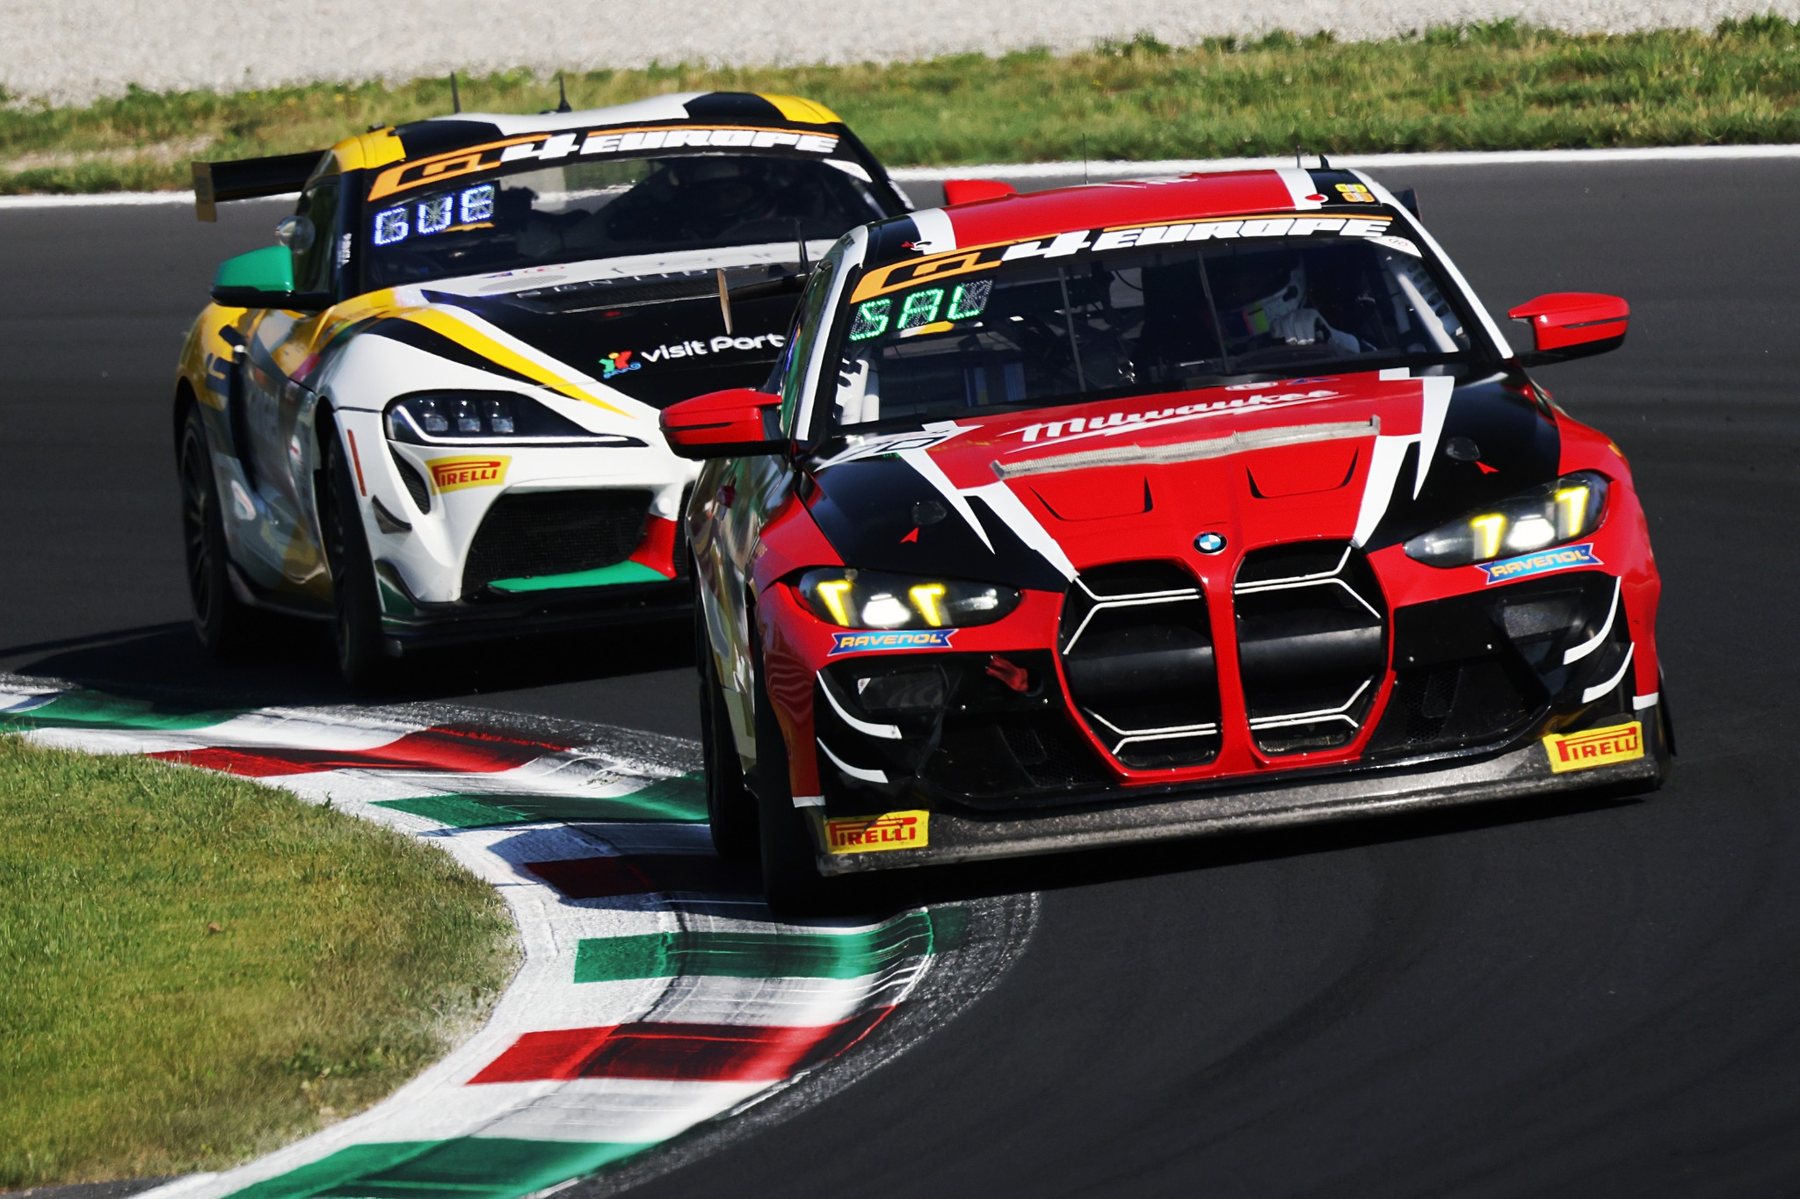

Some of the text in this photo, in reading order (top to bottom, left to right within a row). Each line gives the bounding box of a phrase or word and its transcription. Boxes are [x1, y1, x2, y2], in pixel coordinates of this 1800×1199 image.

[580, 129, 840, 156] EUROPE
[374, 184, 496, 246] GUE
[1091, 218, 1394, 252] EUROPE
[848, 280, 993, 342] SAL
[640, 341, 708, 364] visit
[997, 388, 1345, 444] Milwaukee
[431, 461, 502, 488] PIRELLI
[1490, 549, 1589, 577] RAVENOL
[839, 632, 944, 650] RAVENOL
[1555, 726, 1638, 763] PIRELLI
[828, 816, 918, 847] PIRELLI
